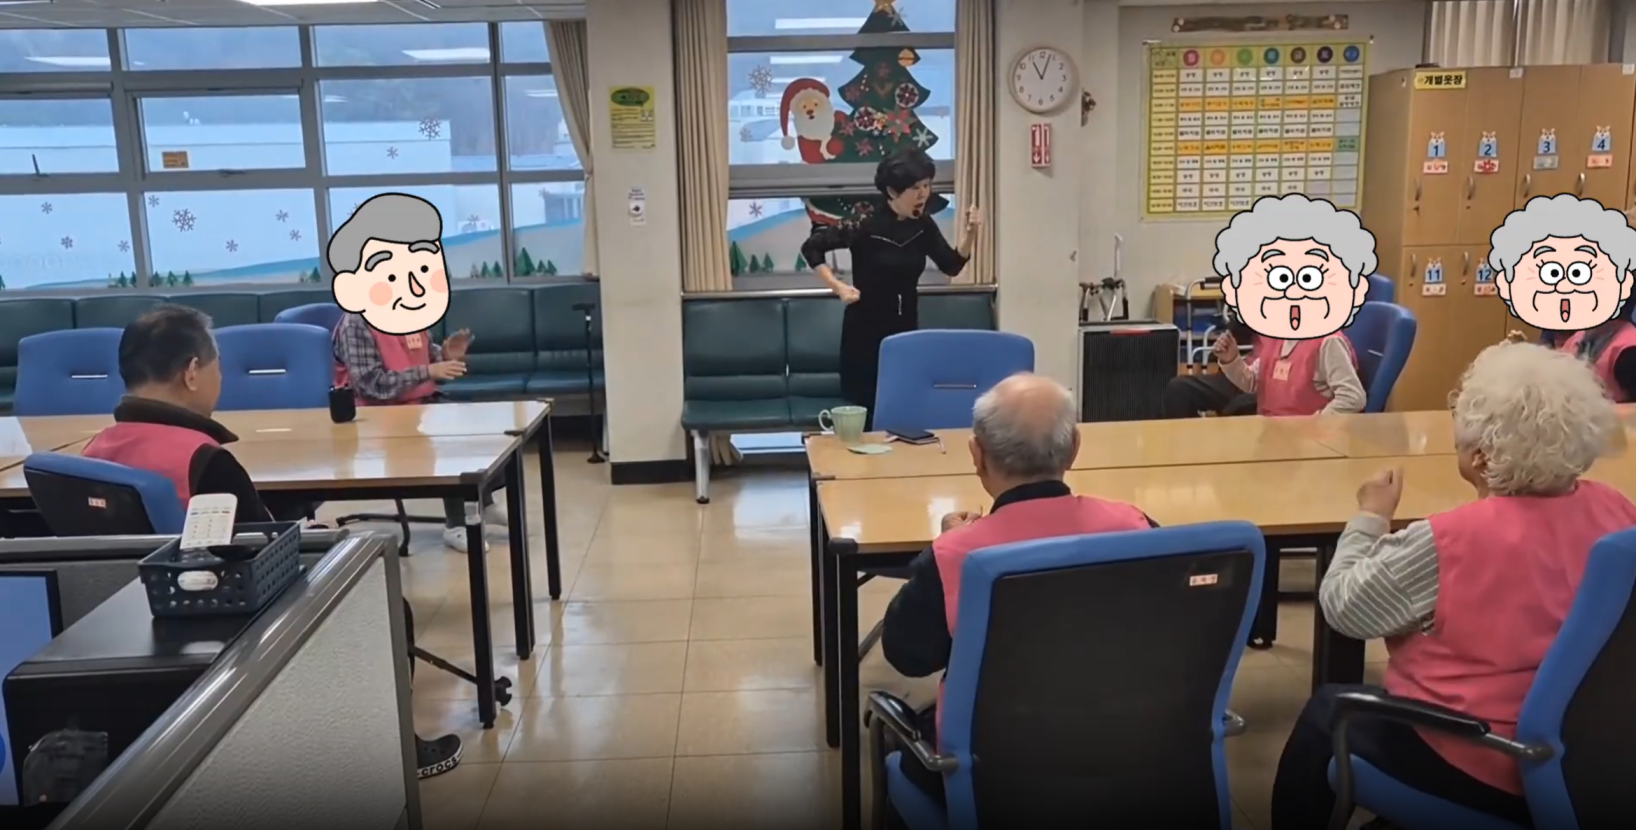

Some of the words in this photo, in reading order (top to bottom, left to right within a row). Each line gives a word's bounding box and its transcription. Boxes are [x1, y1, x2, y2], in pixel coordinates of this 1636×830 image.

[1424, 74, 1463, 86] 개별옷장
[1484, 144, 1492, 156] 2
[1543, 141, 1551, 153] 3
[1597, 138, 1606, 150] 4
[1433, 145, 1439, 157] 1
[1427, 269, 1440, 281] 11
[1478, 269, 1492, 281] 12
[421, 756, 457, 776] crocs
